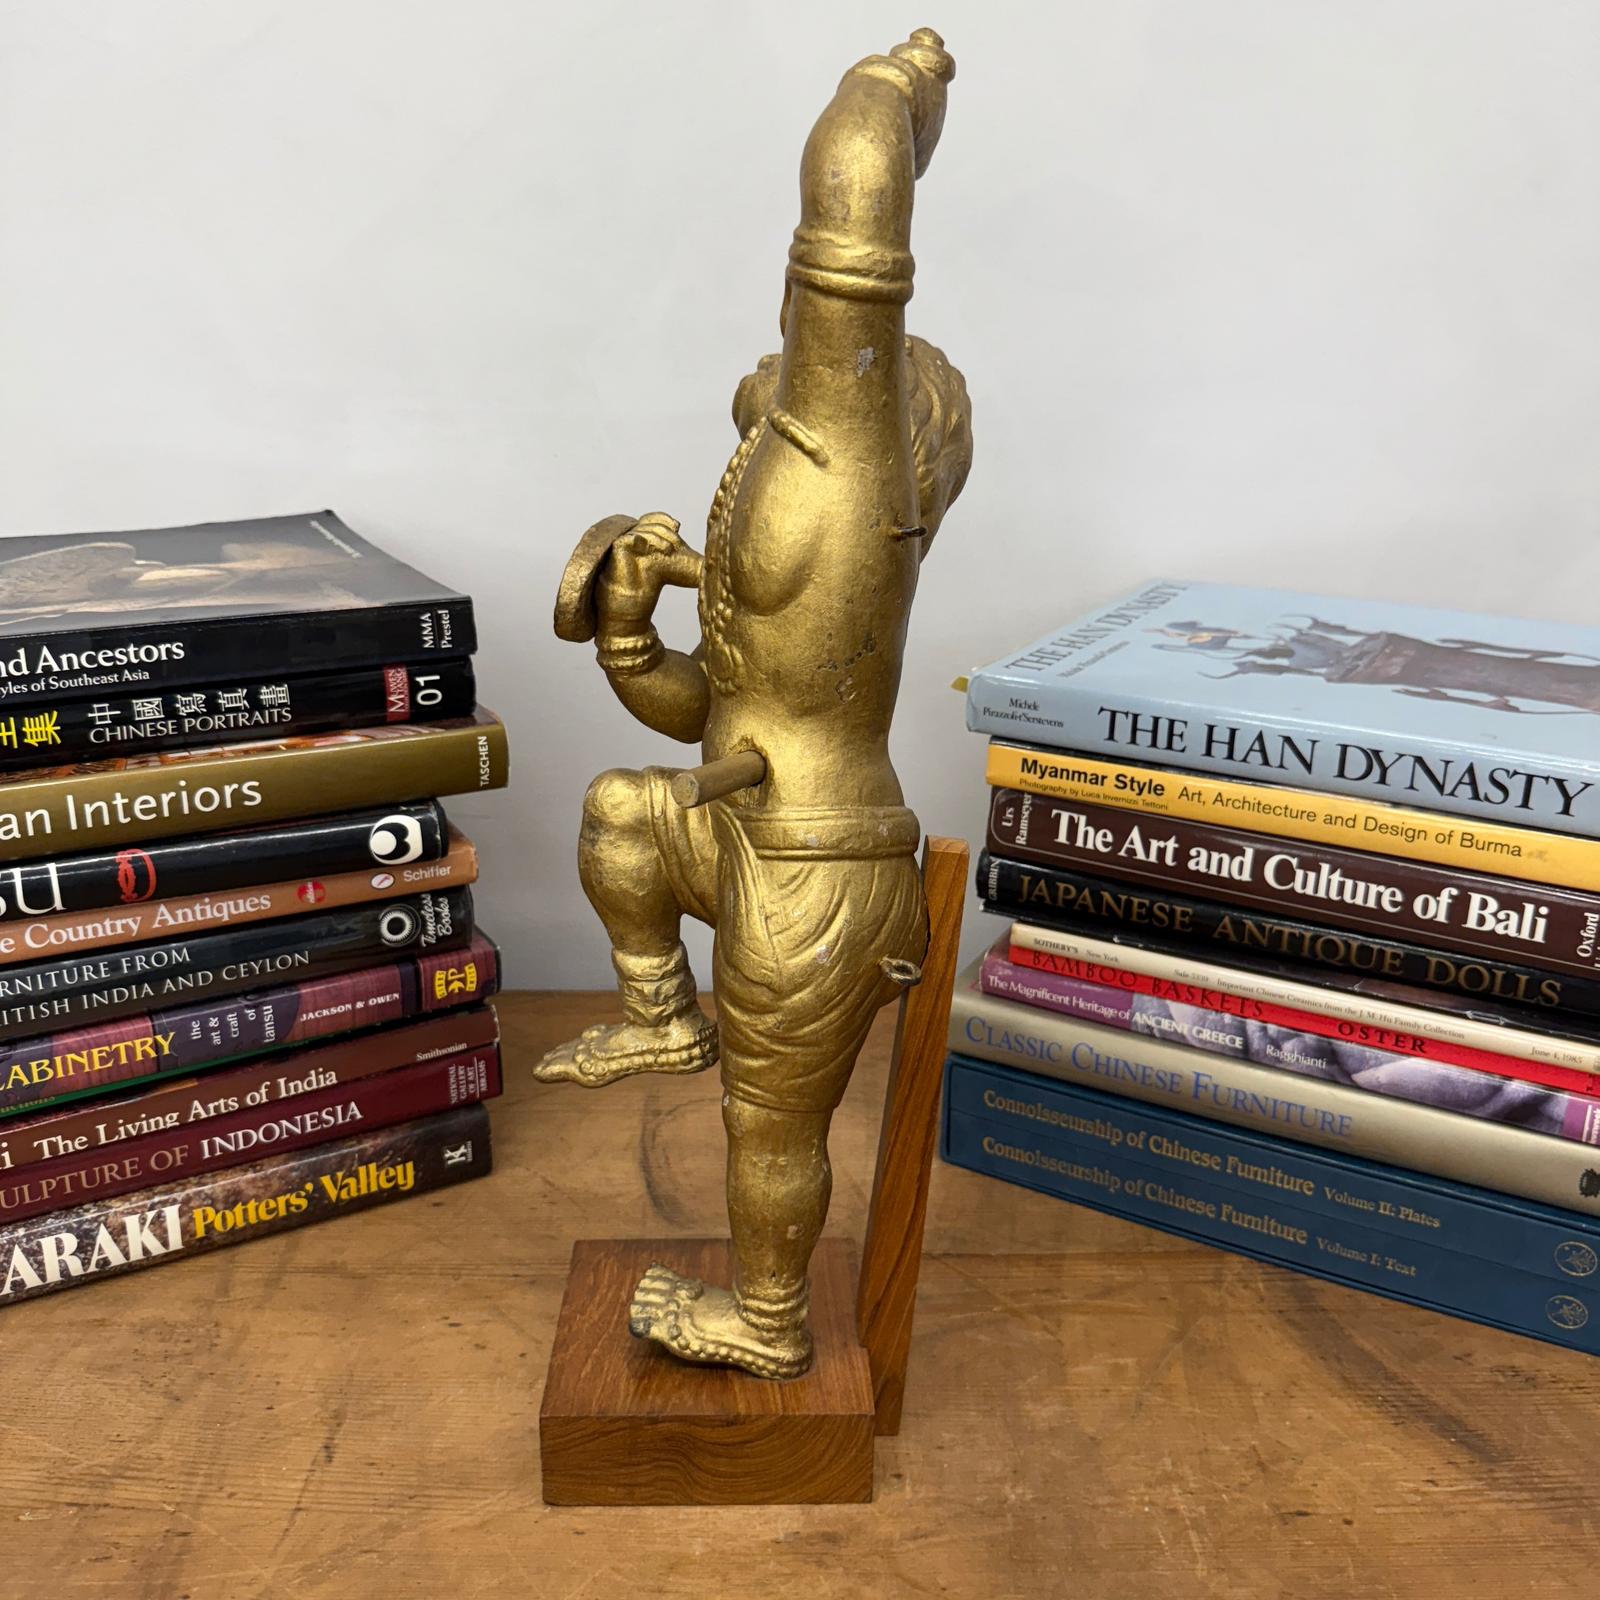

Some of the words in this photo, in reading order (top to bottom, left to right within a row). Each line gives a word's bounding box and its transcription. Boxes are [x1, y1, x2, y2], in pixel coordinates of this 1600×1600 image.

[420, 612, 436, 649] MMA
[437, 609, 453, 649] Prestel
[1003, 648, 1073, 671] THE
[1051, 624, 1119, 650] HAN
[33, 678, 46, 692] of
[49, 672, 119, 690] Southeast
[122, 669, 150, 683] Asia
[36, 641, 185, 675] Ancestors
[415, 674, 443, 706] 01
[90, 719, 178, 744] CHINESE
[185, 707, 292, 734] PORTRAITS
[477, 735, 490, 788] TASCHEN
[1098, 706, 1188, 754] THE
[1202, 723, 1320, 775] HAN
[1333, 743, 1594, 818] DYNASTY
[0, 807, 52, 841] an
[67, 780, 262, 831] Interiors
[1019, 777, 1067, 795] Photography
[1069, 786, 1081, 797] by
[1081, 789, 1101, 799] Luca
[1020, 757, 1108, 787] Myanmar
[1114, 773, 1165, 797] Style
[1178, 786, 1206, 806] Art,
[1212, 791, 1317, 822] Architecture
[1323, 814, 1357, 829] and
[1364, 816, 1428, 843] Design
[1435, 830, 1453, 844] of
[1460, 832, 1522, 857] Burma
[1001, 806, 1014, 828] Urs
[1015, 792, 1033, 846] Ramseyer
[403, 864, 451, 883] Schiffer
[1051, 808, 1113, 853] The
[1117, 825, 1179, 866] Art
[1187, 846, 1254, 883] and
[1263, 853, 1403, 914] Culture
[1413, 887, 1458, 924] of
[1462, 891, 1549, 944] Bali
[24, 913, 142, 949] Country
[152, 894, 271, 929] Antiques
[420, 893, 437, 948] Timeless
[434, 896, 453, 937] Books
[1576, 911, 1599, 958] Oxford
[1018, 874, 1193, 933] JAPANESE
[1212, 914, 1404, 976] ANTIQUE
[1425, 956, 1563, 1007] DOLLS
[1033, 937, 1079, 954] SOTHEBY'S
[0, 961, 111, 999] RNITURE
[122, 947, 191, 974] FROM
[0, 998, 70, 1026] ITISH
[83, 982, 154, 1010] INDIA
[162, 970, 213, 994] AND
[222, 950, 310, 980] CEYLON
[208, 1016, 220, 1028] &
[226, 1011, 239, 1038] craft
[263, 1004, 276, 1043] tansu
[300, 1003, 352, 1022] JACKSON
[356, 1000, 366, 1010] &
[369, 992, 400, 1006] OWEN
[989, 975, 1008, 991] The
[1009, 982, 1069, 1007] Magnificent
[1072, 994, 1117, 1021] Heritage
[1118, 1005, 1131, 1020] of
[1132, 1010, 1189, 1037] ANCIENT
[1192, 1025, 1244, 1050] GREECE
[1266, 1044, 1327, 1069] Ragghianti
[1032, 950, 1137, 988] BAMBOO
[1152, 976, 1264, 1018] BASKETS
[1338, 1022, 1426, 1054] OSTER
[190, 1020, 202, 1040] the
[211, 1030, 221, 1046] art
[416, 1041, 468, 1062] Smithsonian
[0, 1031, 175, 1092] ABINETRY
[33, 1135, 89, 1161] The
[96, 1113, 179, 1146] Living
[188, 1096, 239, 1122] Arts
[246, 1081, 271, 1106] of
[277, 1067, 338, 1099] India
[0, 1158, 142, 1209] ULPTURE
[151, 1145, 189, 1172] OF
[200, 1101, 363, 1160] INDONESIA
[983, 1090, 1124, 1147] Connoisseurship
[1127, 1131, 1145, 1149] of
[1149, 1135, 1221, 1172] Chinese
[1226, 1155, 1315, 1196] Furniture
[1324, 1186, 1375, 1212] Volume
[1399, 1205, 1441, 1229] Plates
[0, 1204, 185, 1296] ARAKI
[192, 1182, 314, 1239] Potters'
[320, 1160, 415, 1204] Valley
[982, 1136, 1121, 1193] Connoisseurship
[1124, 1178, 1143, 1196] of
[1145, 1182, 1215, 1218] Chinese
[1220, 1203, 1308, 1245] Furniture
[1318, 1236, 1368, 1263] Volume
[1385, 1256, 1416, 1277] Text
